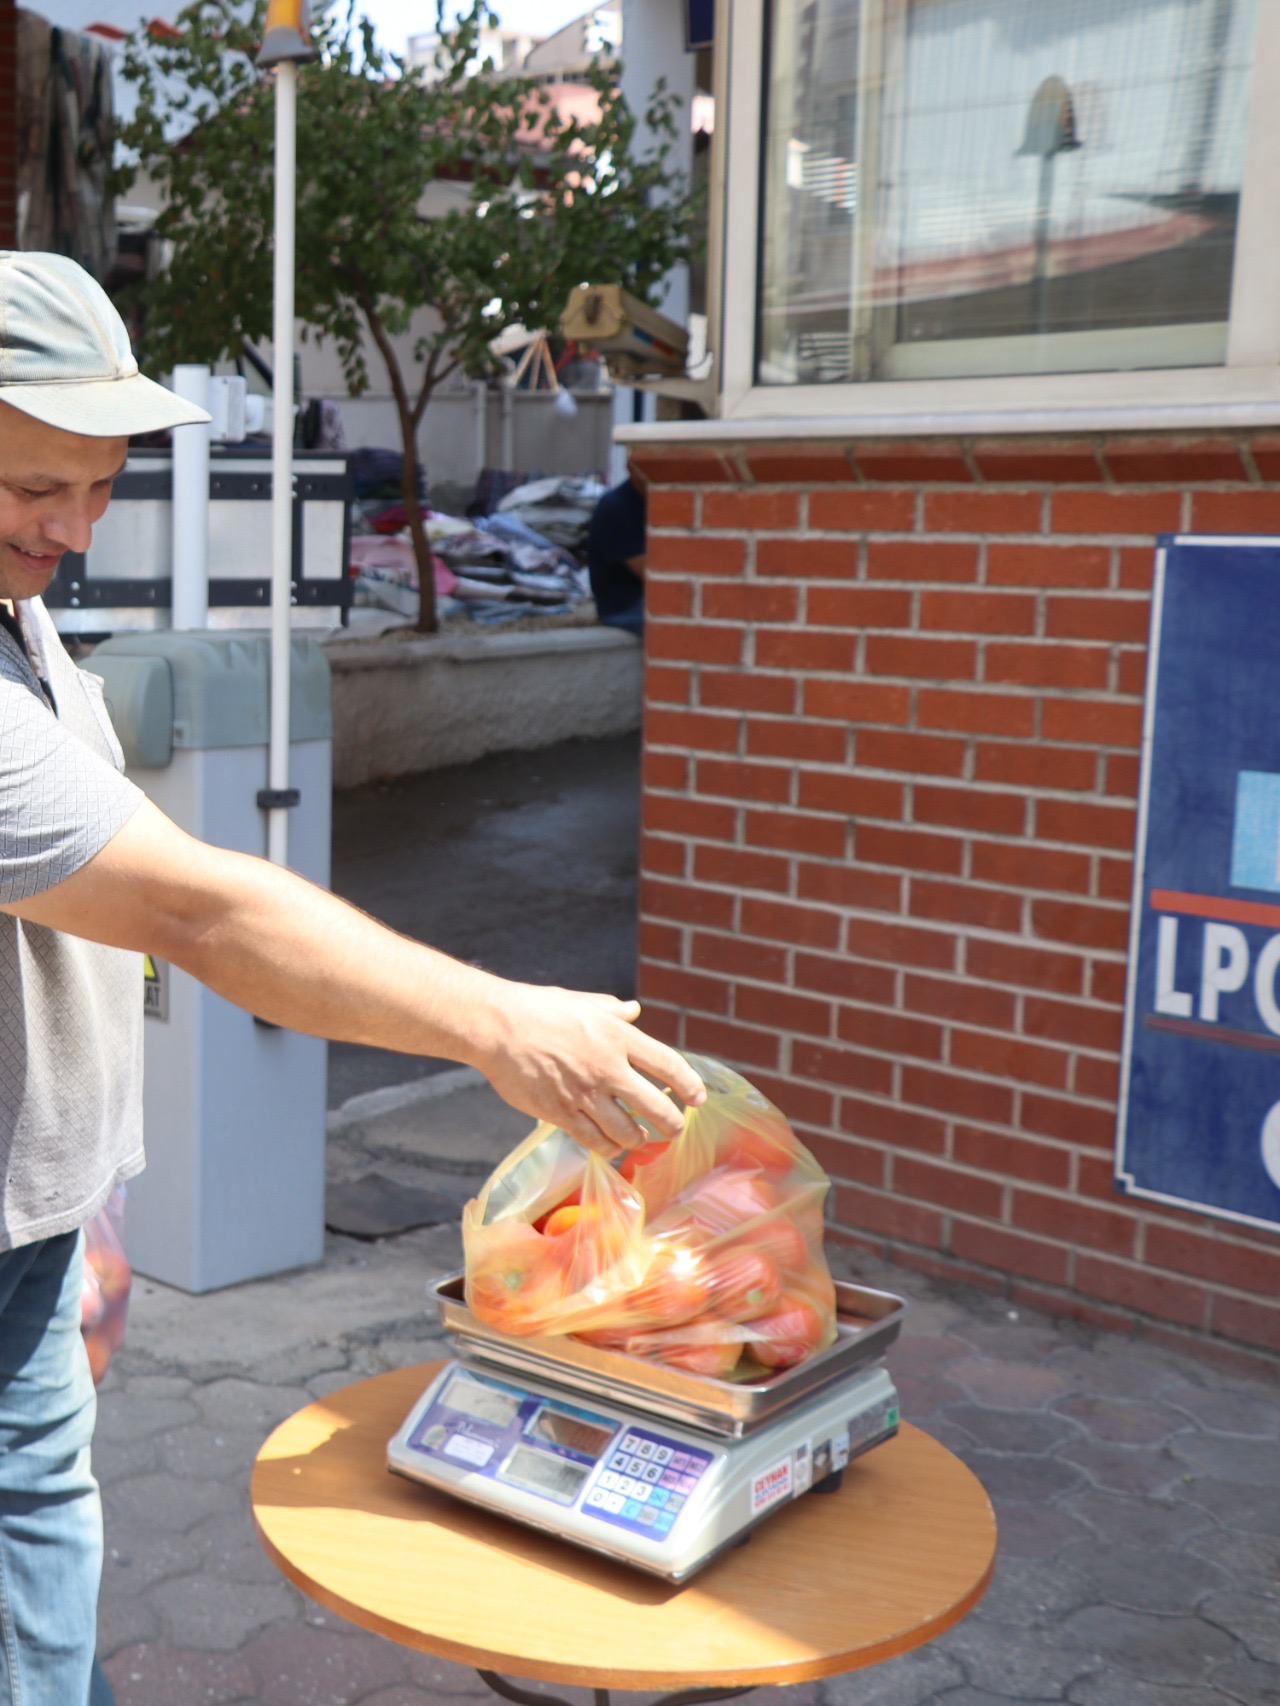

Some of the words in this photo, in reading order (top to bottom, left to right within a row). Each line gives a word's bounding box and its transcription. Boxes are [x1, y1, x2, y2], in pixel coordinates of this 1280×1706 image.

[625, 1438, 635, 1449] 7
[640, 1444, 651, 1455] 8
[657, 1449, 668, 1460] 9
[614, 1456, 624, 1466] 4
[631, 1462, 641, 1472] 5
[646, 1467, 658, 1478] 6
